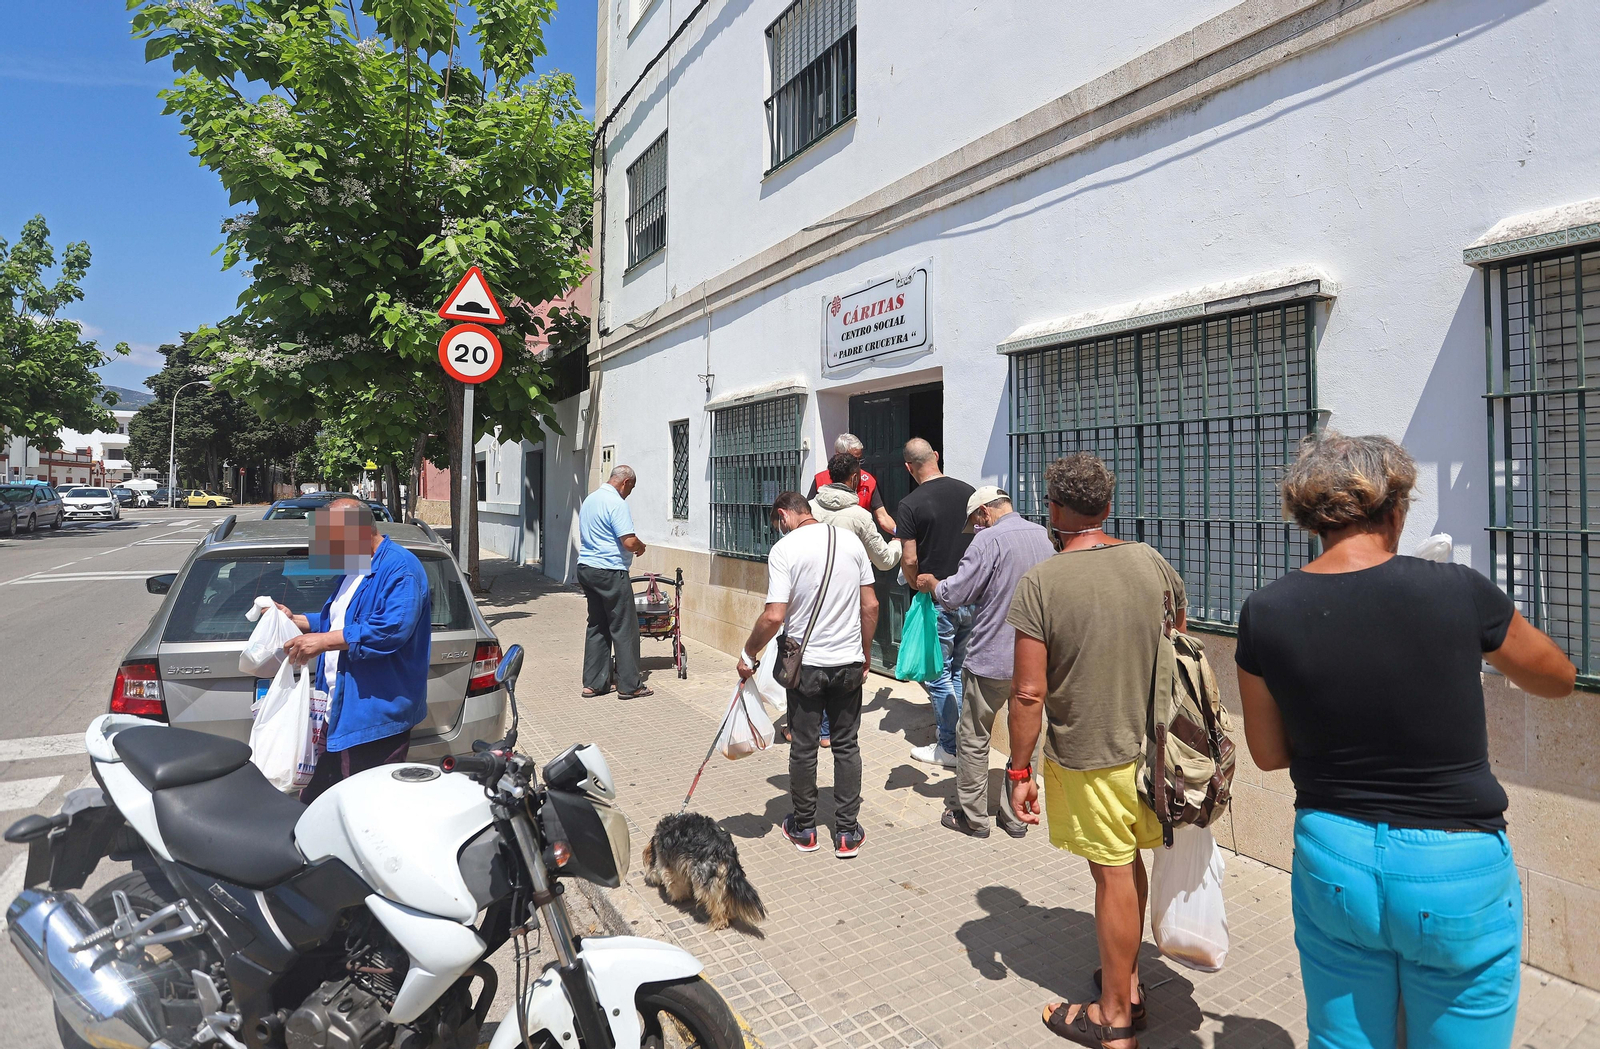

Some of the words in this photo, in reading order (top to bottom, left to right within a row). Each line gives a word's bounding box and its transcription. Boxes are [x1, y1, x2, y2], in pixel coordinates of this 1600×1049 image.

[842, 293, 905, 326] CÁRITAS
[841, 325, 871, 342] CENTRO
[873, 315, 905, 332] SOCIAL
[454, 344, 488, 364] 20
[838, 345, 863, 359] PADRE
[864, 333, 909, 352] CRUCEYRA
